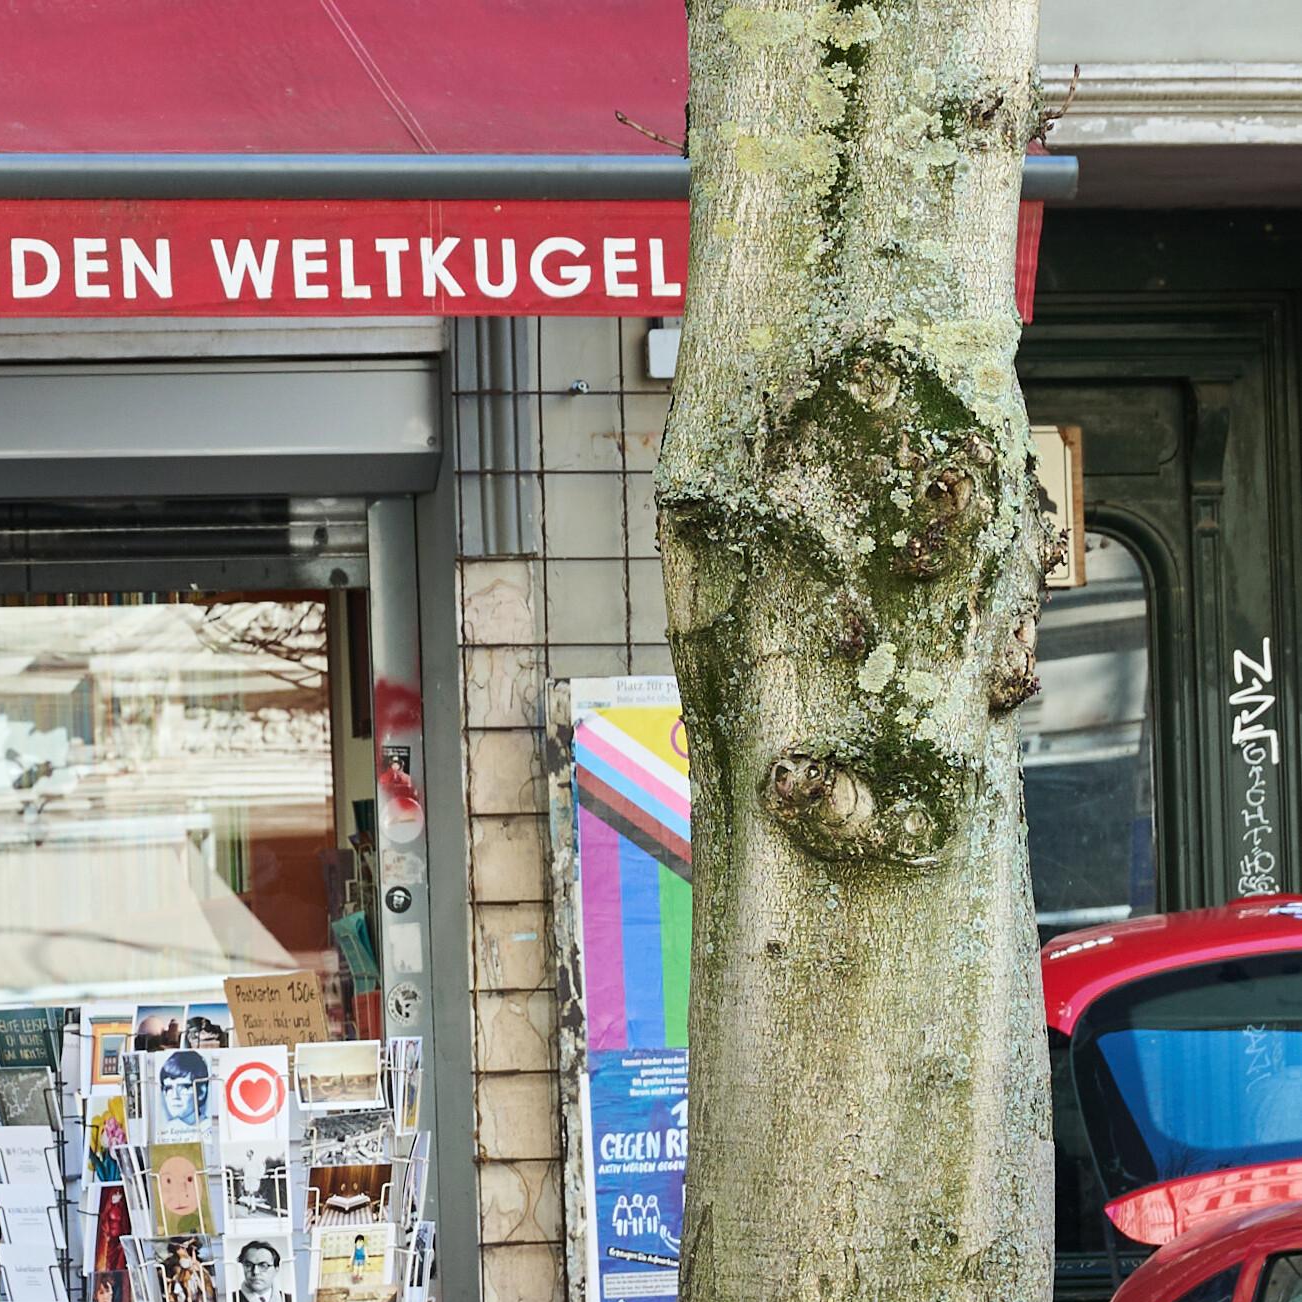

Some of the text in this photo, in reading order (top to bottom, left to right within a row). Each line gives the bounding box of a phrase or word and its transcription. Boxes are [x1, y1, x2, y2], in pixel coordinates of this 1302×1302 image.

[211, 236, 682, 300] WELTKUGEL
[236, 981, 316, 1003] Postkarten 1,50€
[599, 1130, 661, 1161] GEGEN
